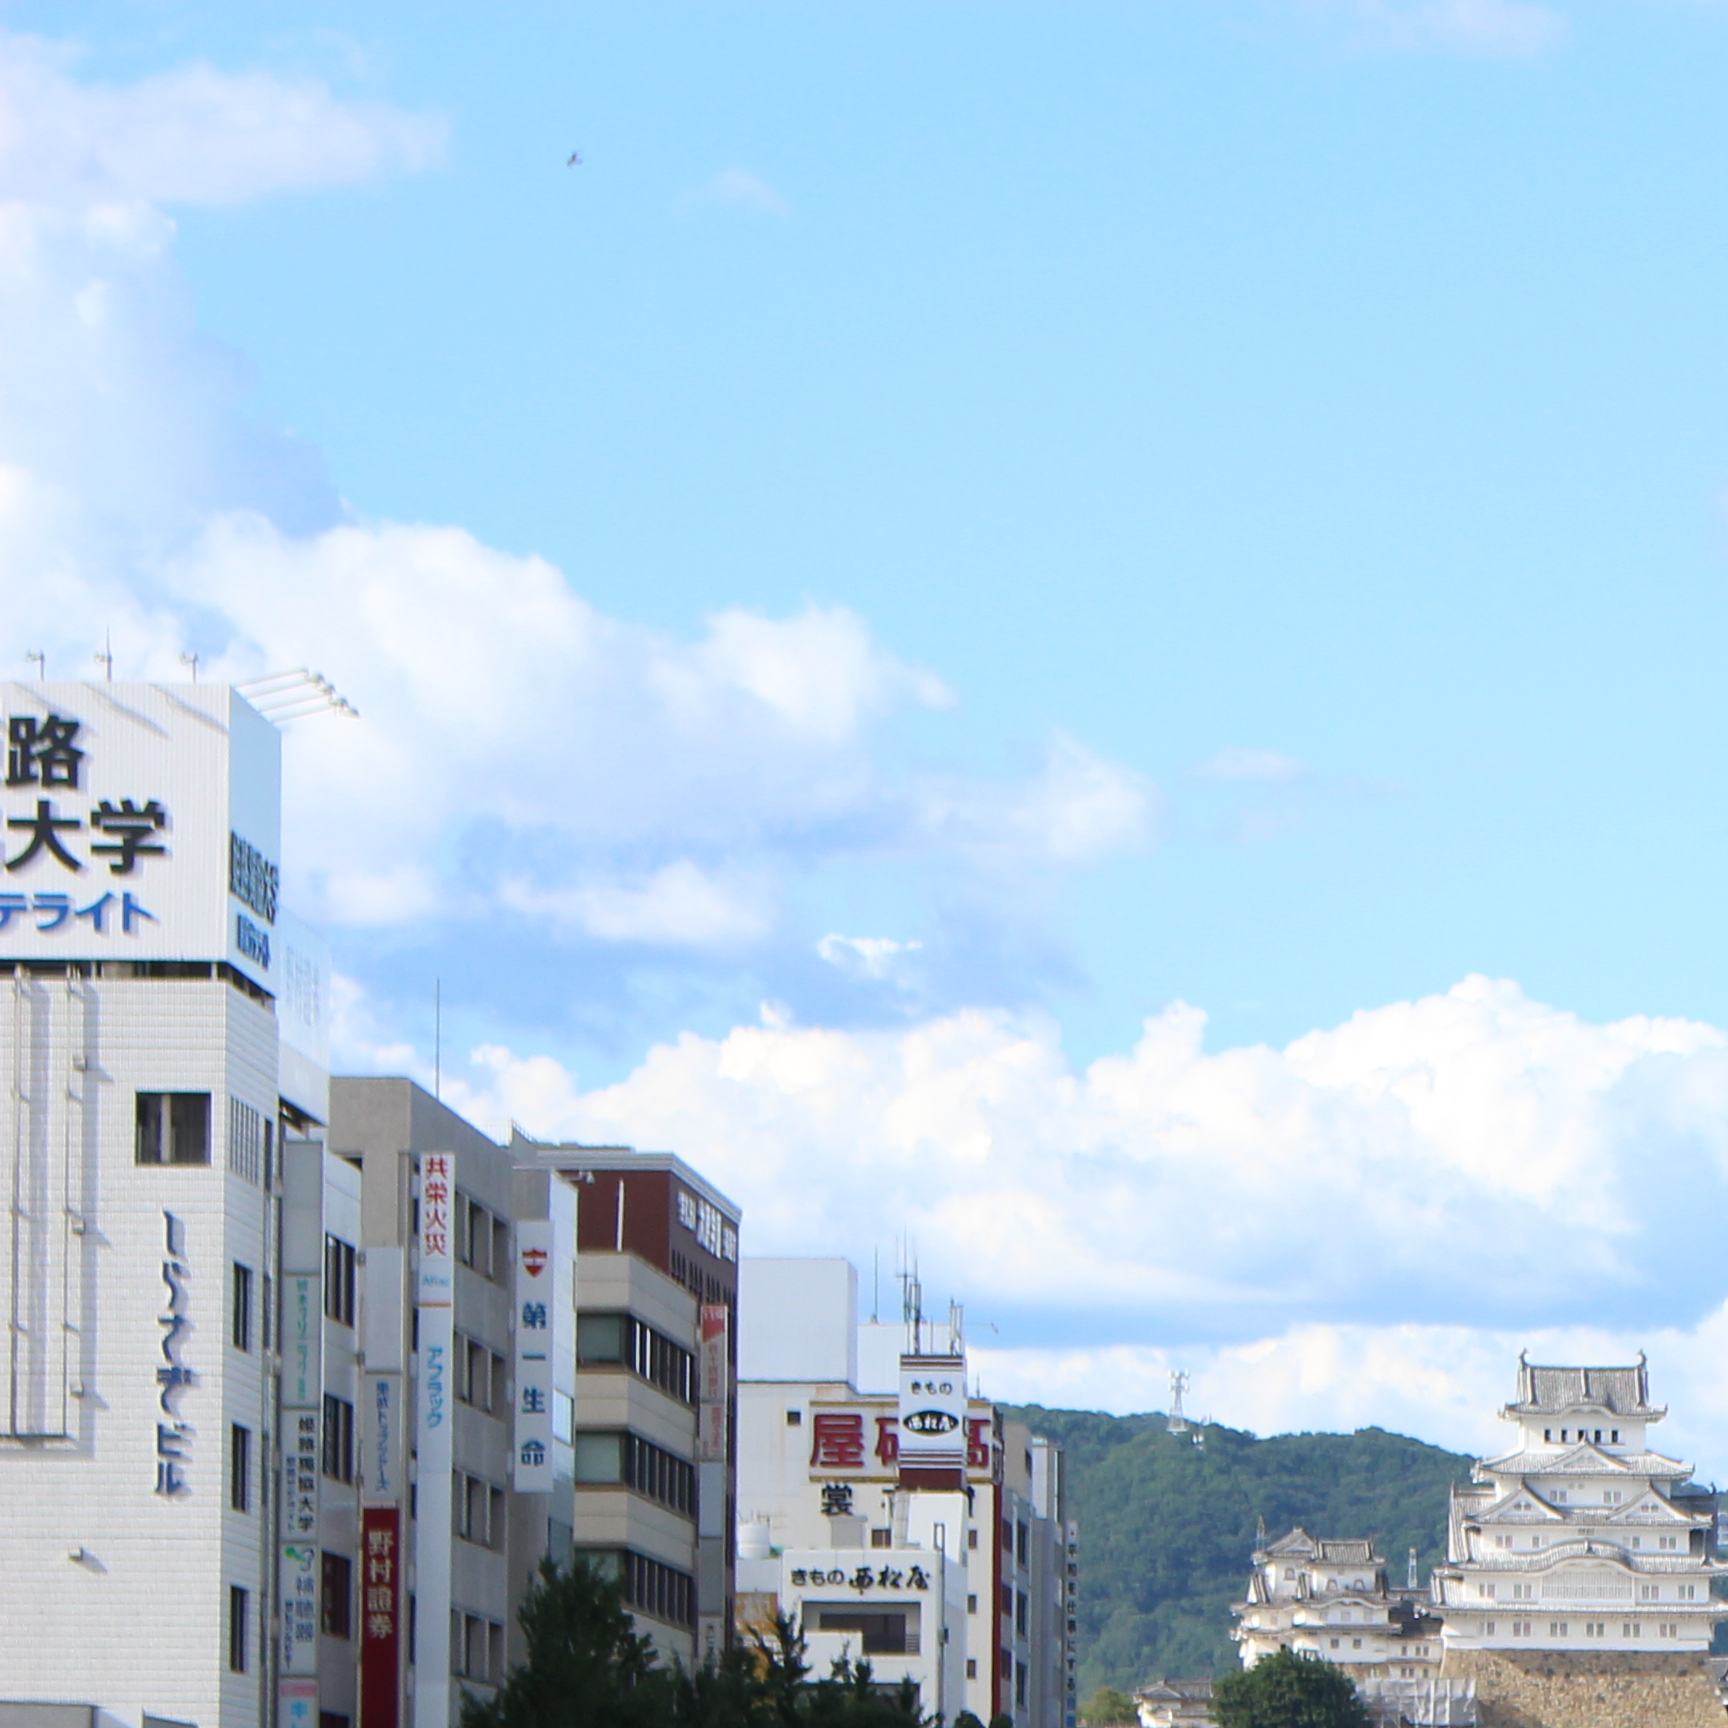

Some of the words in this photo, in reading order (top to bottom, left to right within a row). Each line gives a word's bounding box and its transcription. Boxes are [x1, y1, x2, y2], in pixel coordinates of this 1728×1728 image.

[4, 799, 166, 873] 大学
[425, 1156, 448, 1257] 共栄火災
[427, 1346, 444, 1428] アフラック
[521, 1301, 548, 1467] 第一生命
[910, 1381, 953, 1396] きもの
[367, 1529, 394, 1640] 野村證券
[790, 1568, 845, 1587] きもの
